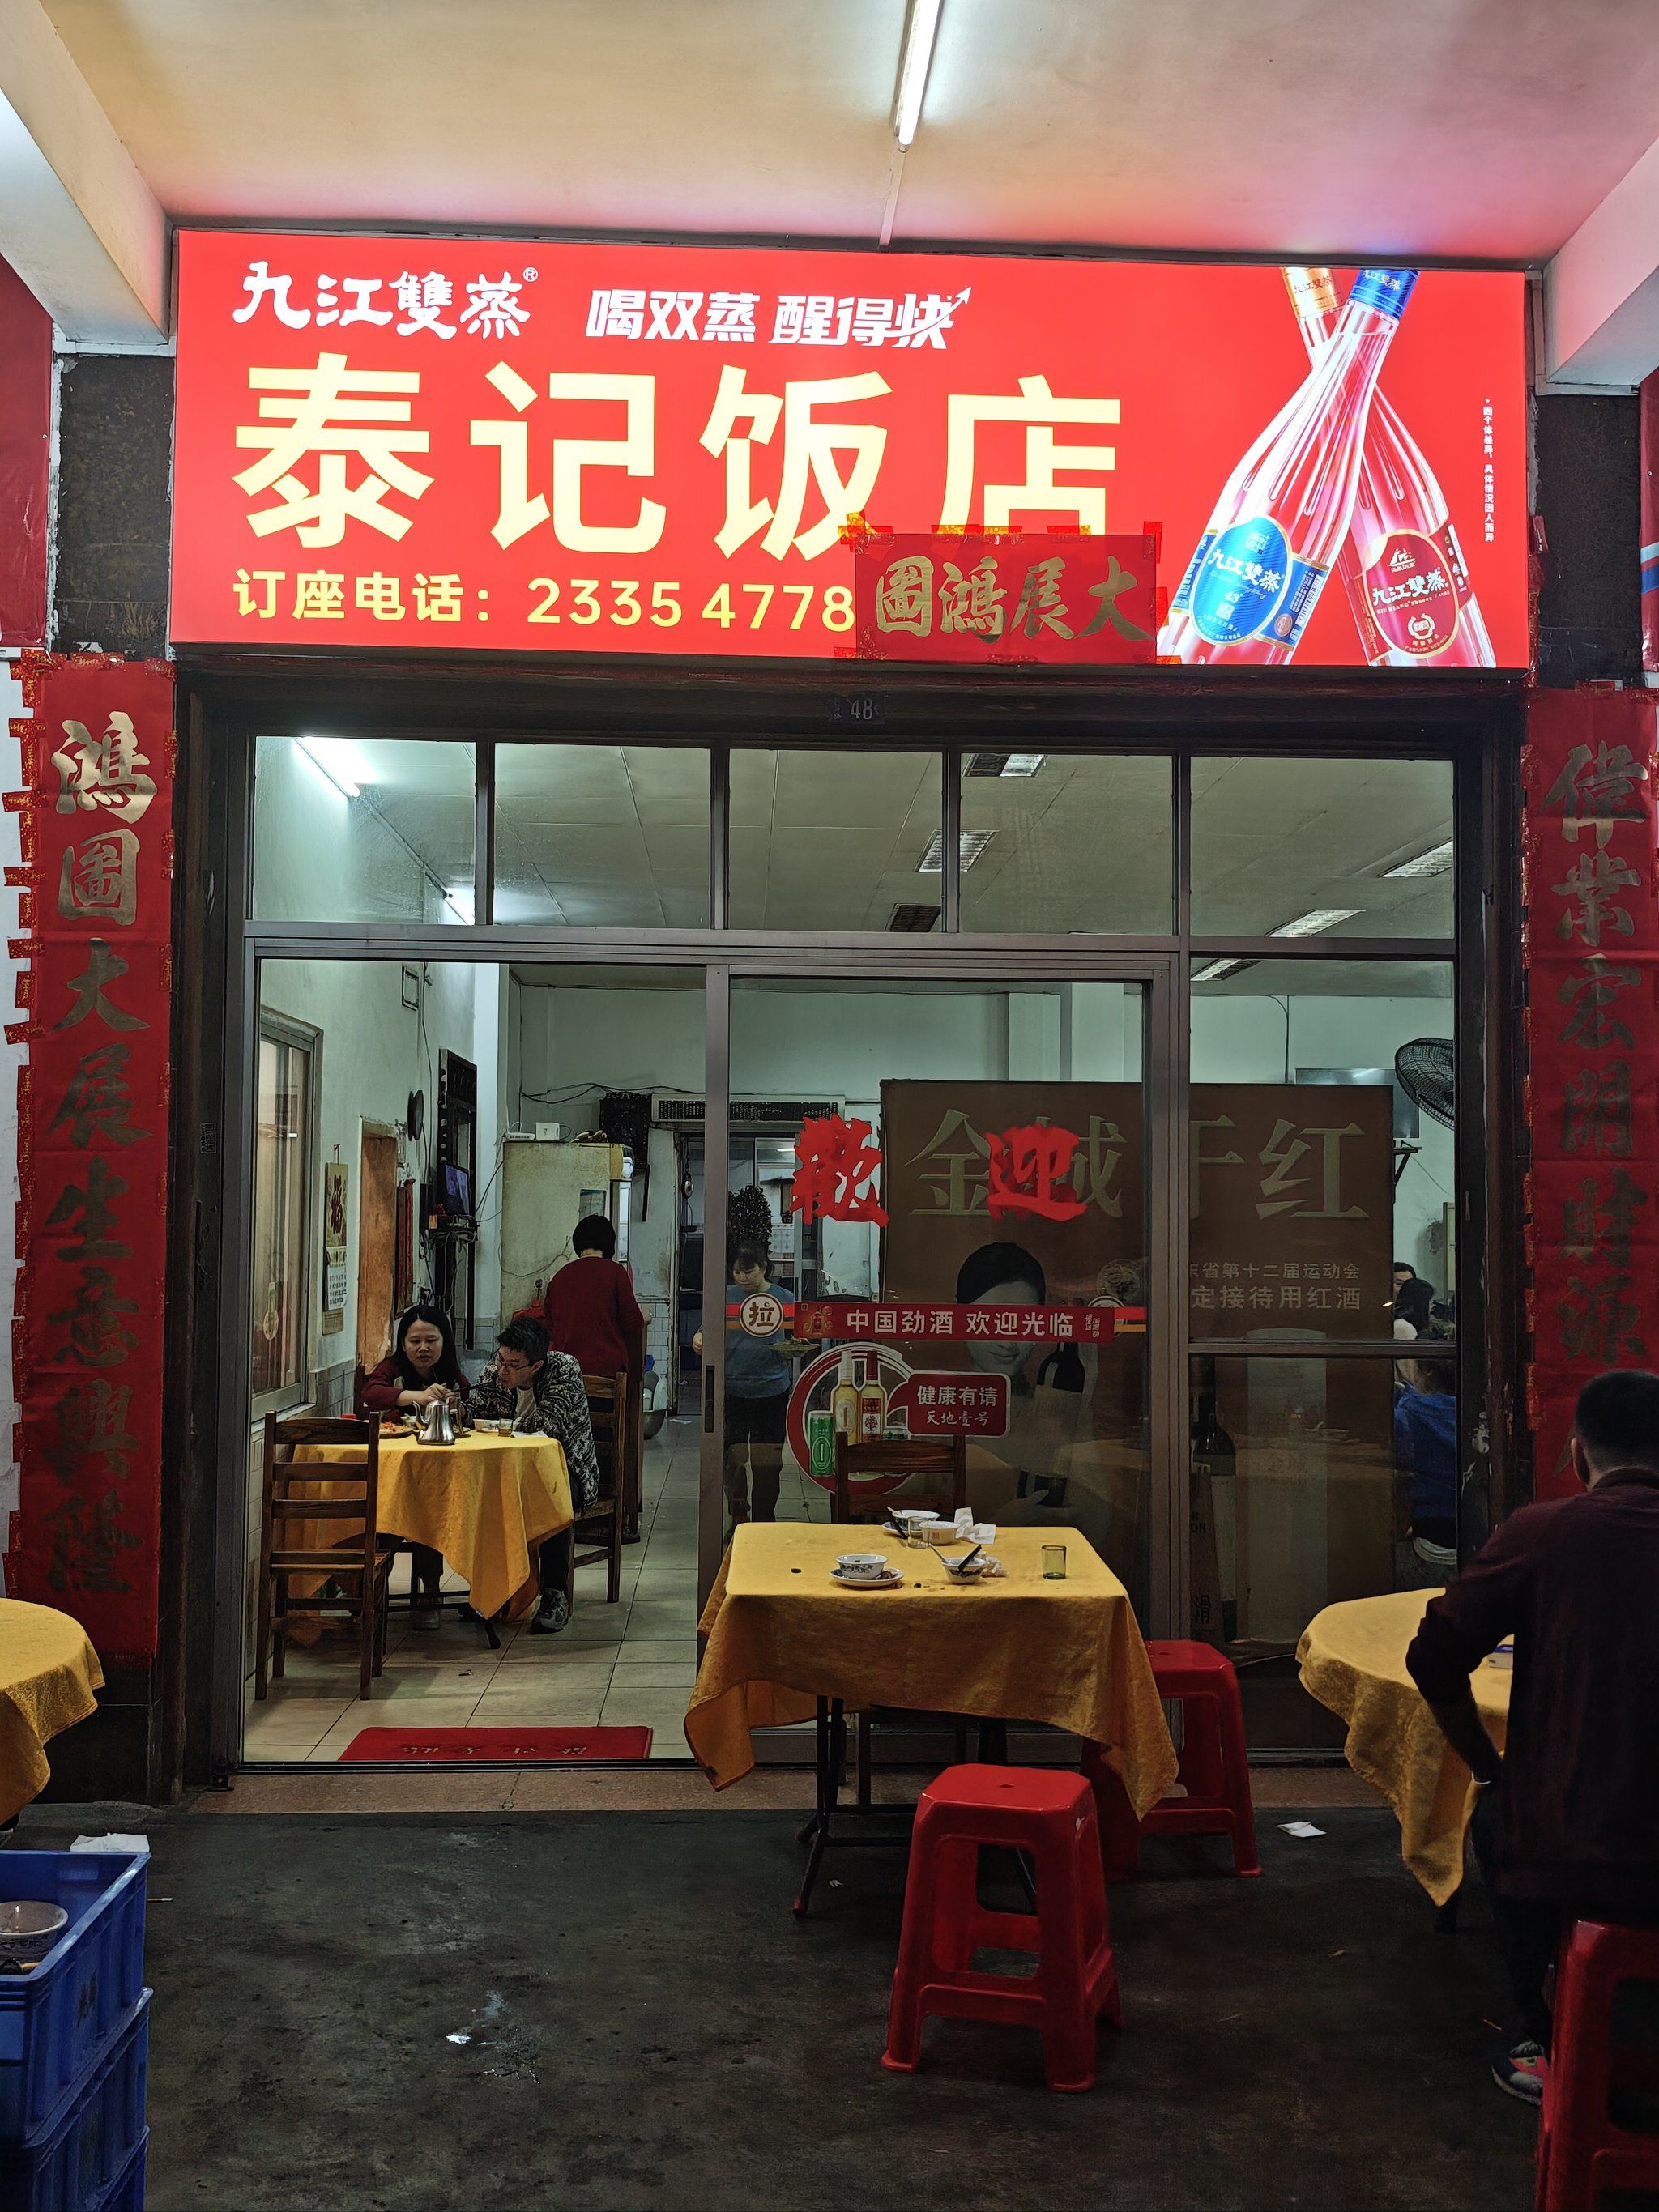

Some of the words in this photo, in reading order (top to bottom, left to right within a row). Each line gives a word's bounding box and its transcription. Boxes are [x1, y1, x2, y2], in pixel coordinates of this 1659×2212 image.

[585, 289, 760, 343] 喝双蒸
[768, 292, 957, 349] 醒得快
[232, 352, 1121, 563] 泰记饭店
[527, 578, 682, 627] 2335
[702, 583, 855, 630] 4778
[851, 698, 873, 720] 48
[1542, 739, 1649, 1478] 偉業宏開財源
[43, 710, 157, 1594] 鴻圖大展生意興隆
[1191, 1285, 1362, 1311] 定接待用红酒
[748, 1301, 774, 1328] 拉
[847, 1308, 953, 1336] 中国劲酒
[966, 1311, 1073, 1337] 欢迎光临
[917, 1384, 999, 1407] 健康有请
[926, 1410, 990, 1426] 天地壹号
